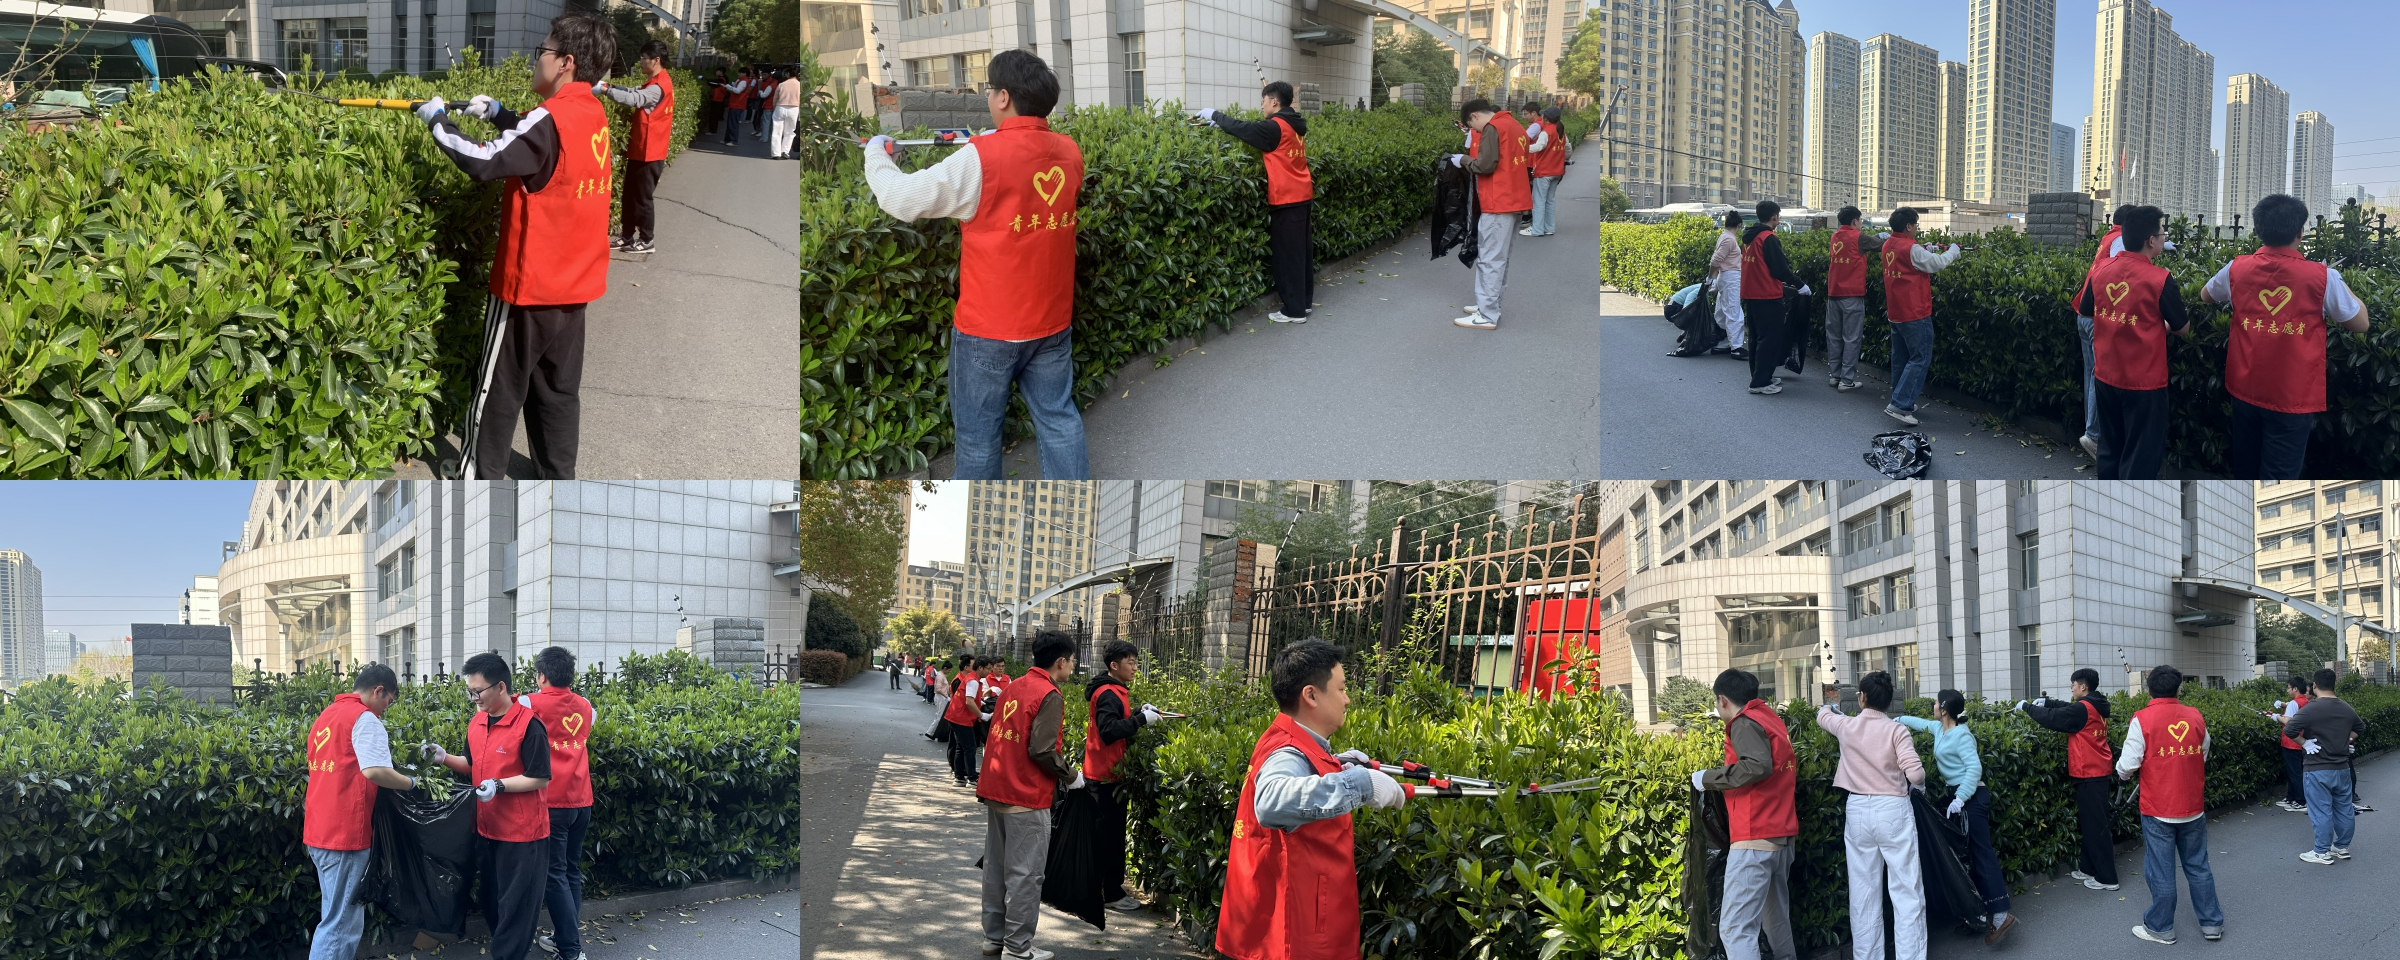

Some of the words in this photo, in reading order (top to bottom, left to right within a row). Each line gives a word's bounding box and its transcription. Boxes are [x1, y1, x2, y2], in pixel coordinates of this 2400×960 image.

[1287, 148, 1306, 158] 青年志
[2240, 317, 2306, 336] 青年志愿者
[2157, 744, 2202, 757] 青年志愿者
